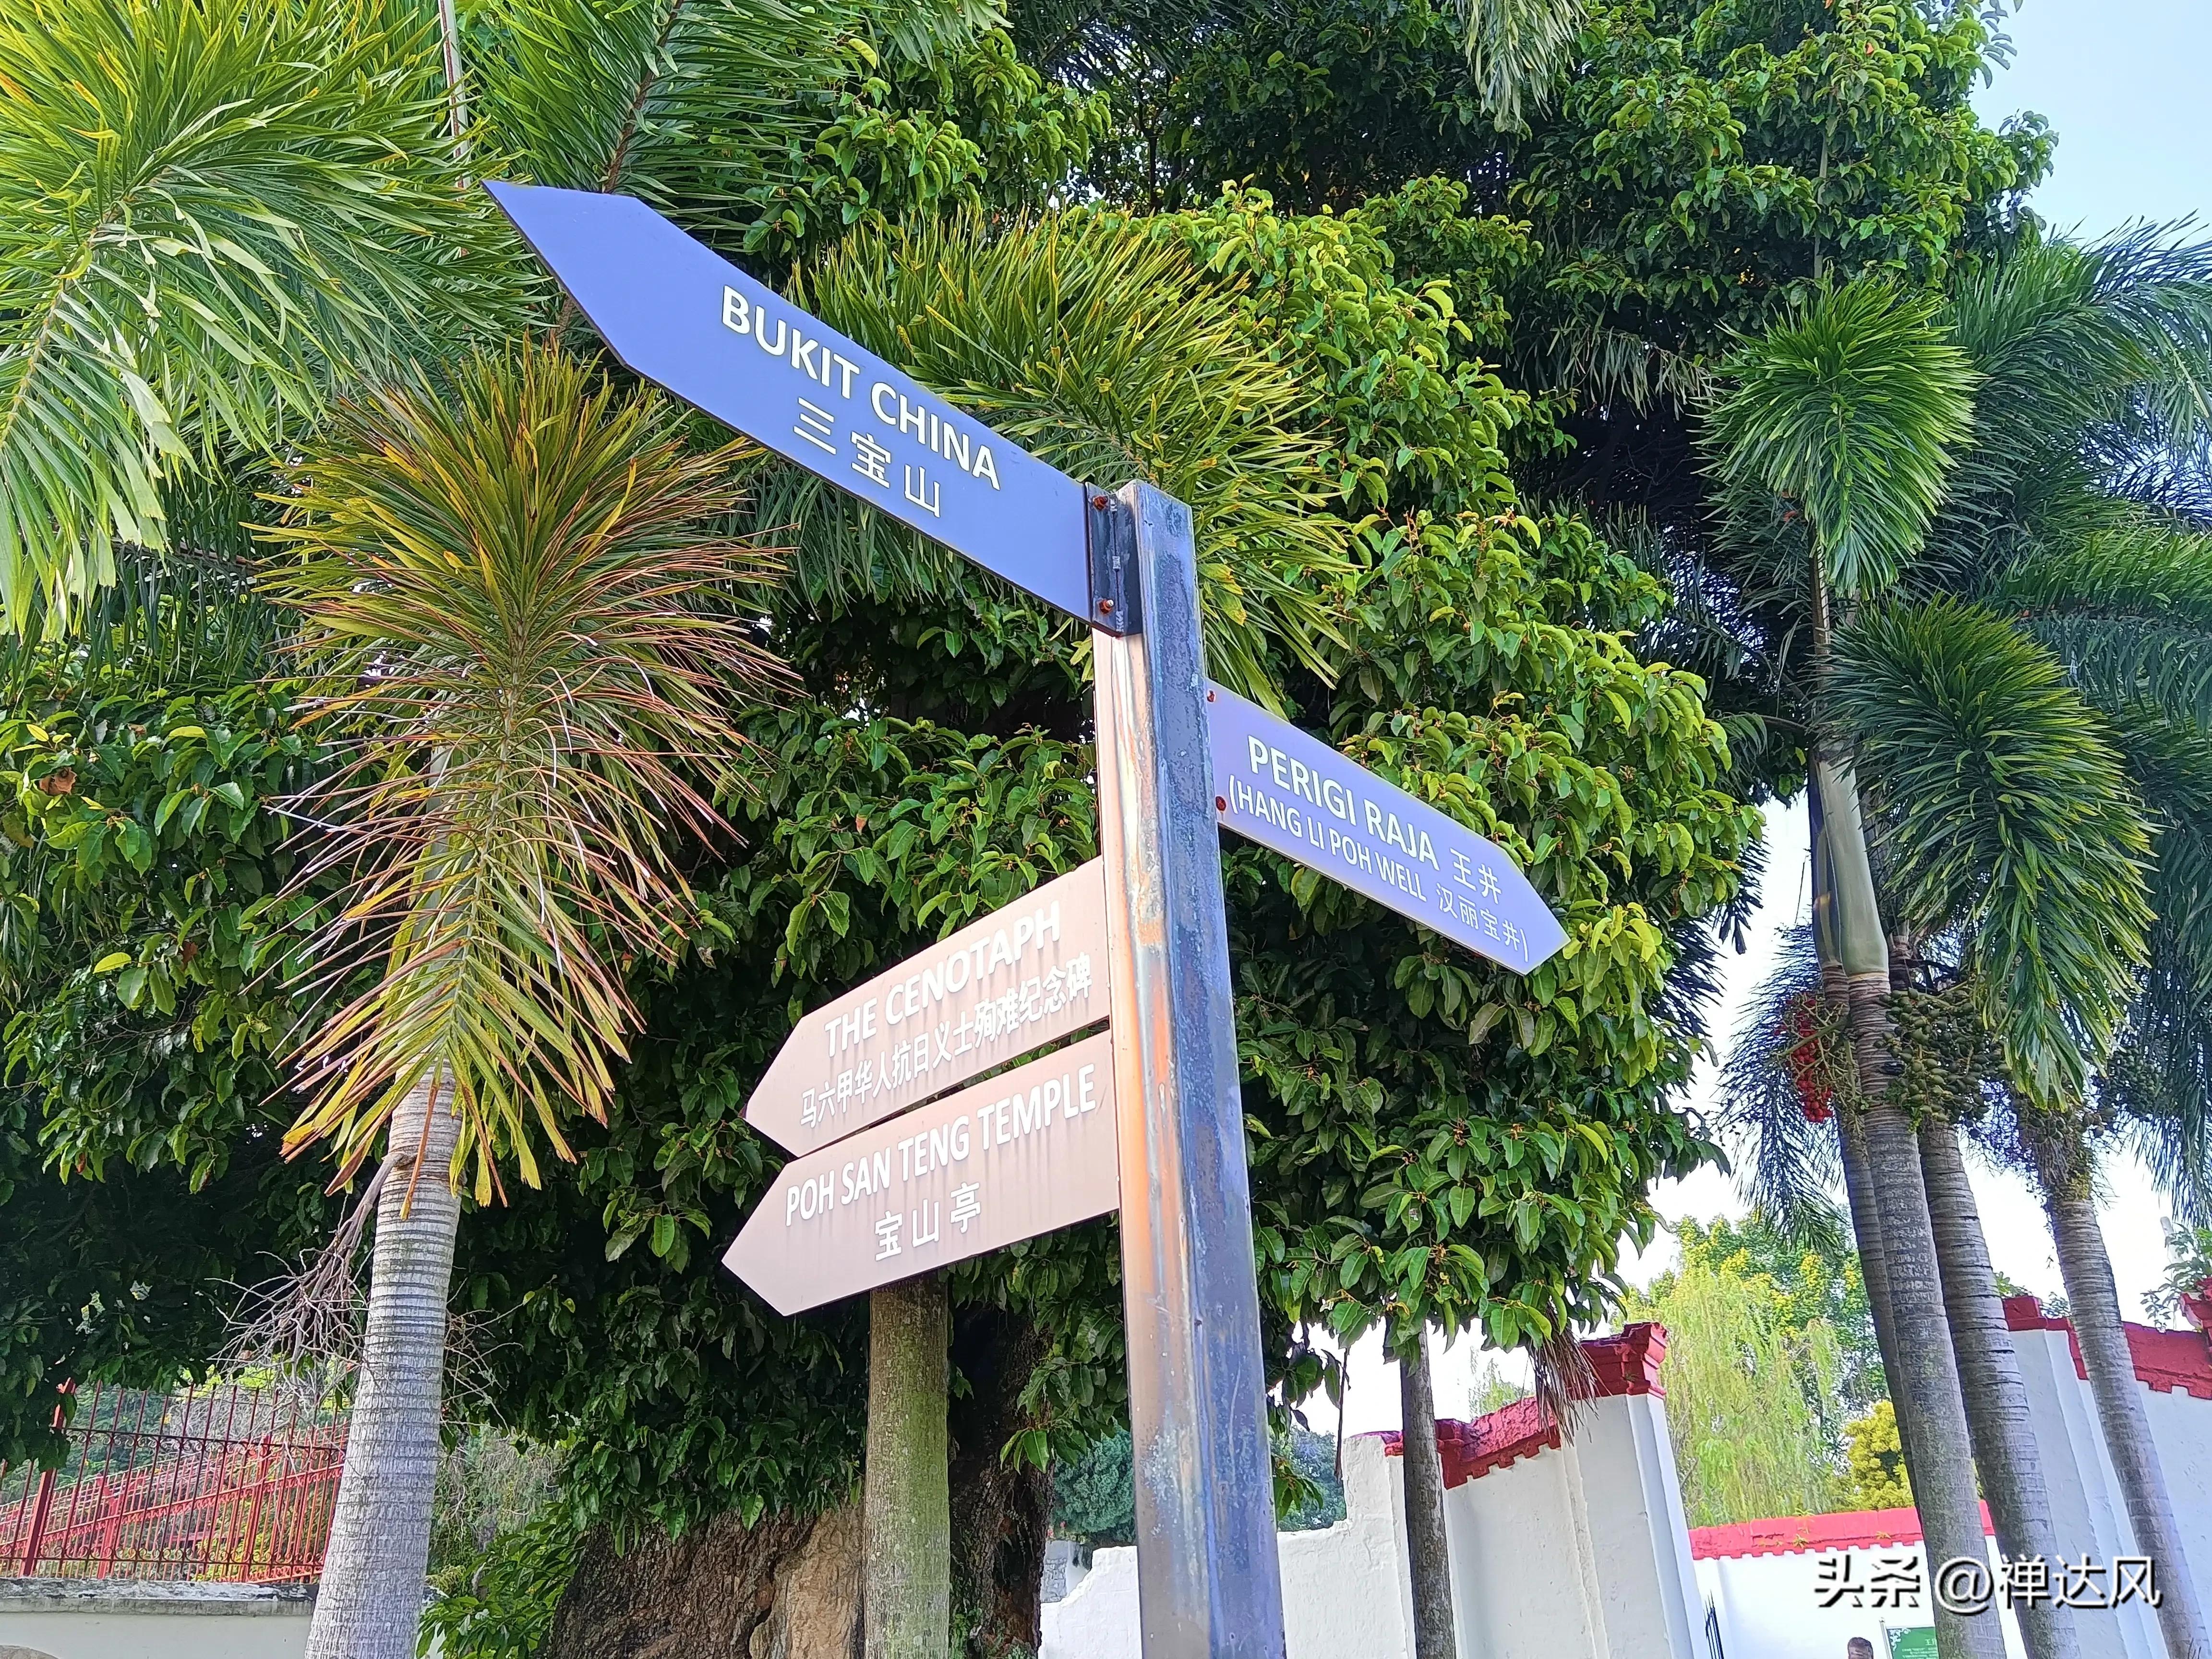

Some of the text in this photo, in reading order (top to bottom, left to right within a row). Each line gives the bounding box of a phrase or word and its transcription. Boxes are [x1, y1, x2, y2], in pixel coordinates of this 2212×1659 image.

[721, 285, 1000, 491] BUKIT CHINA
[793, 397, 940, 518] 三宝山
[1228, 774, 1529, 962] (HANG LI POH WELL 汉丽宝井)
[1248, 735, 1502, 904] PERIGI RAJA 王井
[799, 952, 1093, 1129] 马六甲华人抗日义士殉难纪念碑
[824, 900, 1061, 1058] THE CENOTAPH
[785, 1063, 1097, 1227] POH SAN TENG TEMPLE
[874, 1182, 982, 1262] 宝山亭
